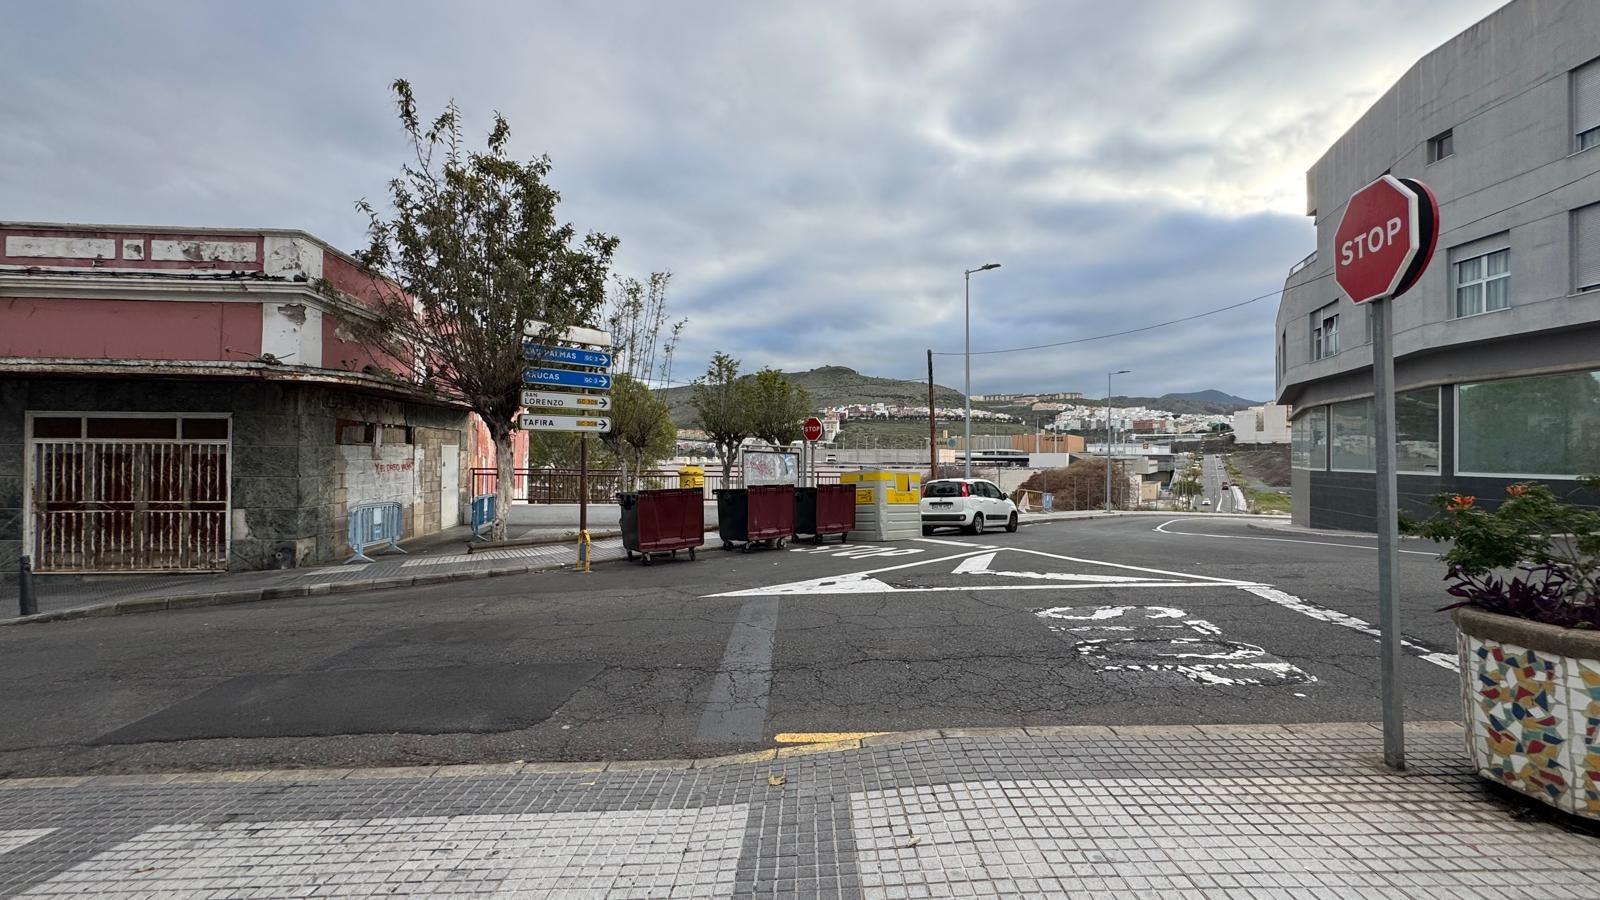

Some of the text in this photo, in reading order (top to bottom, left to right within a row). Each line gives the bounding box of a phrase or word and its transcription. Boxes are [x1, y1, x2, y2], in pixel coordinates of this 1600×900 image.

[1341, 216, 1402, 266] STOP
[524, 397, 564, 406] LORENZO
[790, 544, 926, 560] STOP
